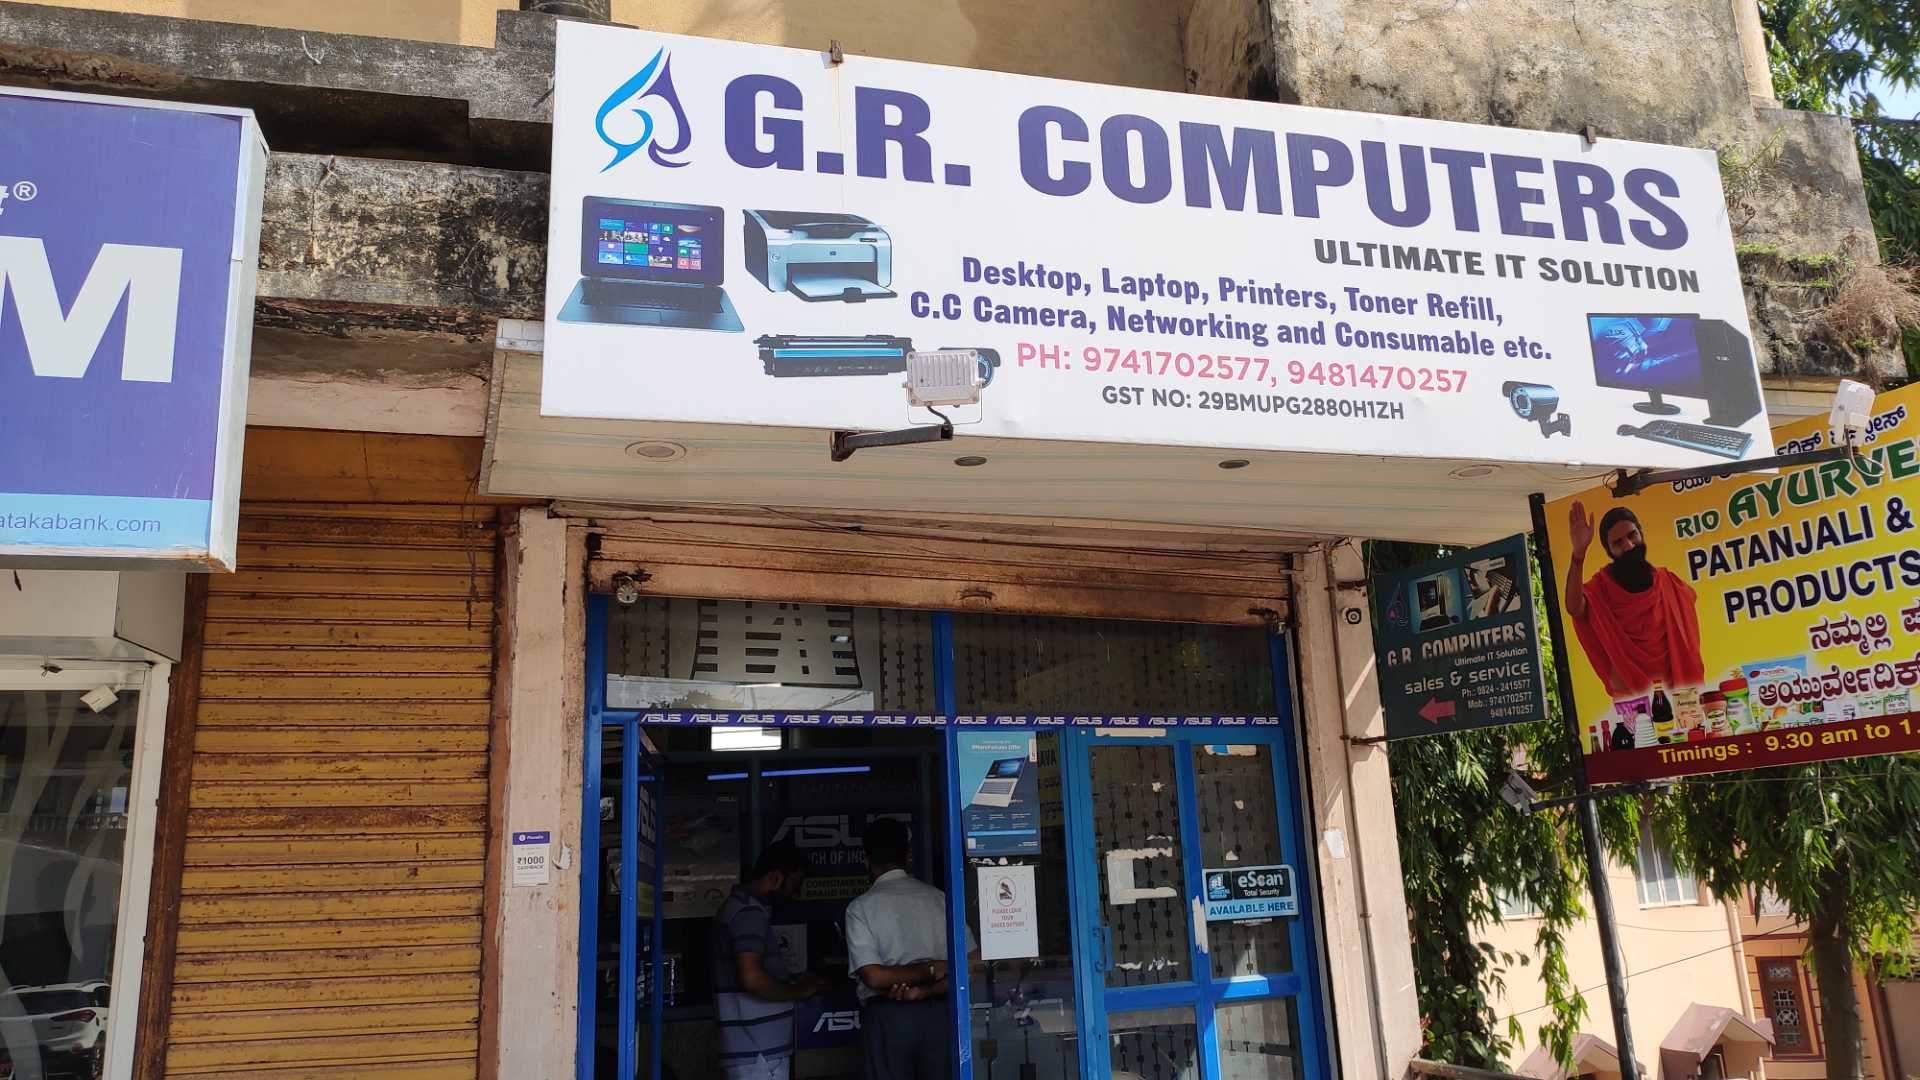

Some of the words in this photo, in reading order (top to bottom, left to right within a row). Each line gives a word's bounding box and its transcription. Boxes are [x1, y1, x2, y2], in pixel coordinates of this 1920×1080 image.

[723, 73, 972, 188] G.R.
[1017, 104, 1691, 251] COMPUTERS
[1313, 238, 1486, 276] ULTIMATE
[1494, 253, 1527, 279] IT
[1537, 256, 1700, 293] SOLUTION
[962, 256, 1092, 296] Desktop,
[1101, 267, 1210, 304] Laptop,
[1218, 276, 1337, 315] Printers,
[1344, 286, 1418, 316] Toner
[1426, 293, 1503, 327] Refill,
[910, 291, 962, 321] C.C
[973, 296, 1097, 334] Camera,
[1107, 305, 1270, 348] Networking
[1277, 320, 1326, 346] and
[1335, 321, 1495, 356] Consumable
[1503, 336, 1553, 360] etc.
[1016, 342, 1072, 371] PH:
[1082, 346, 1278, 388] 9741702577,
[1287, 359, 1468, 393] 9481470257
[1102, 385, 1145, 406] GST
[1152, 388, 1192, 409] NO:
[1675, 510, 1720, 539] RIO
[1687, 505, 1874, 581] PATANJALI
[1886, 497, 1915, 533] &
[1723, 550, 1920, 624] PRODUCTS
[1421, 622, 1527, 660] COMPUTERS
[1454, 655, 1486, 667] Ultimate
[1487, 651, 1495, 662] IT
[1495, 647, 1528, 660] Solution
[1404, 677, 1445, 695] sales
[1450, 671, 1463, 687] &
[1468, 661, 1531, 684] service
[640, 713, 682, 723] ASUS
[689, 713, 730, 724] ASUS
[736, 714, 775, 724] ASUS
[782, 715, 821, 725] ASUS
[827, 715, 865, 725] ASUS
[871, 715, 908, 725] ASUS
[911, 716, 947, 725] ASUS
[953, 716, 988, 725] ASUS
[993, 716, 1027, 725] ASUS
[1032, 716, 1065, 725] ASUS
[1071, 716, 1103, 725] ASUS
[1108, 717, 1140, 725] ASUS
[1148, 717, 1179, 725] ASUS
[1183, 717, 1213, 725] ASUS
[1217, 717, 1247, 725] ASUS
[1251, 717, 1279, 725] ASUS
[1658, 740, 1740, 766] Timings
[1764, 732, 1814, 752] 9.30
[1821, 728, 1858, 746] am
[1864, 722, 1891, 740] to
[1238, 871, 1284, 888] eScan
[1243, 889, 1258, 897] Total
[1260, 887, 1280, 897] Security
[1209, 902, 1265, 916] AVAILABLE
[1268, 901, 1294, 912] HERE
